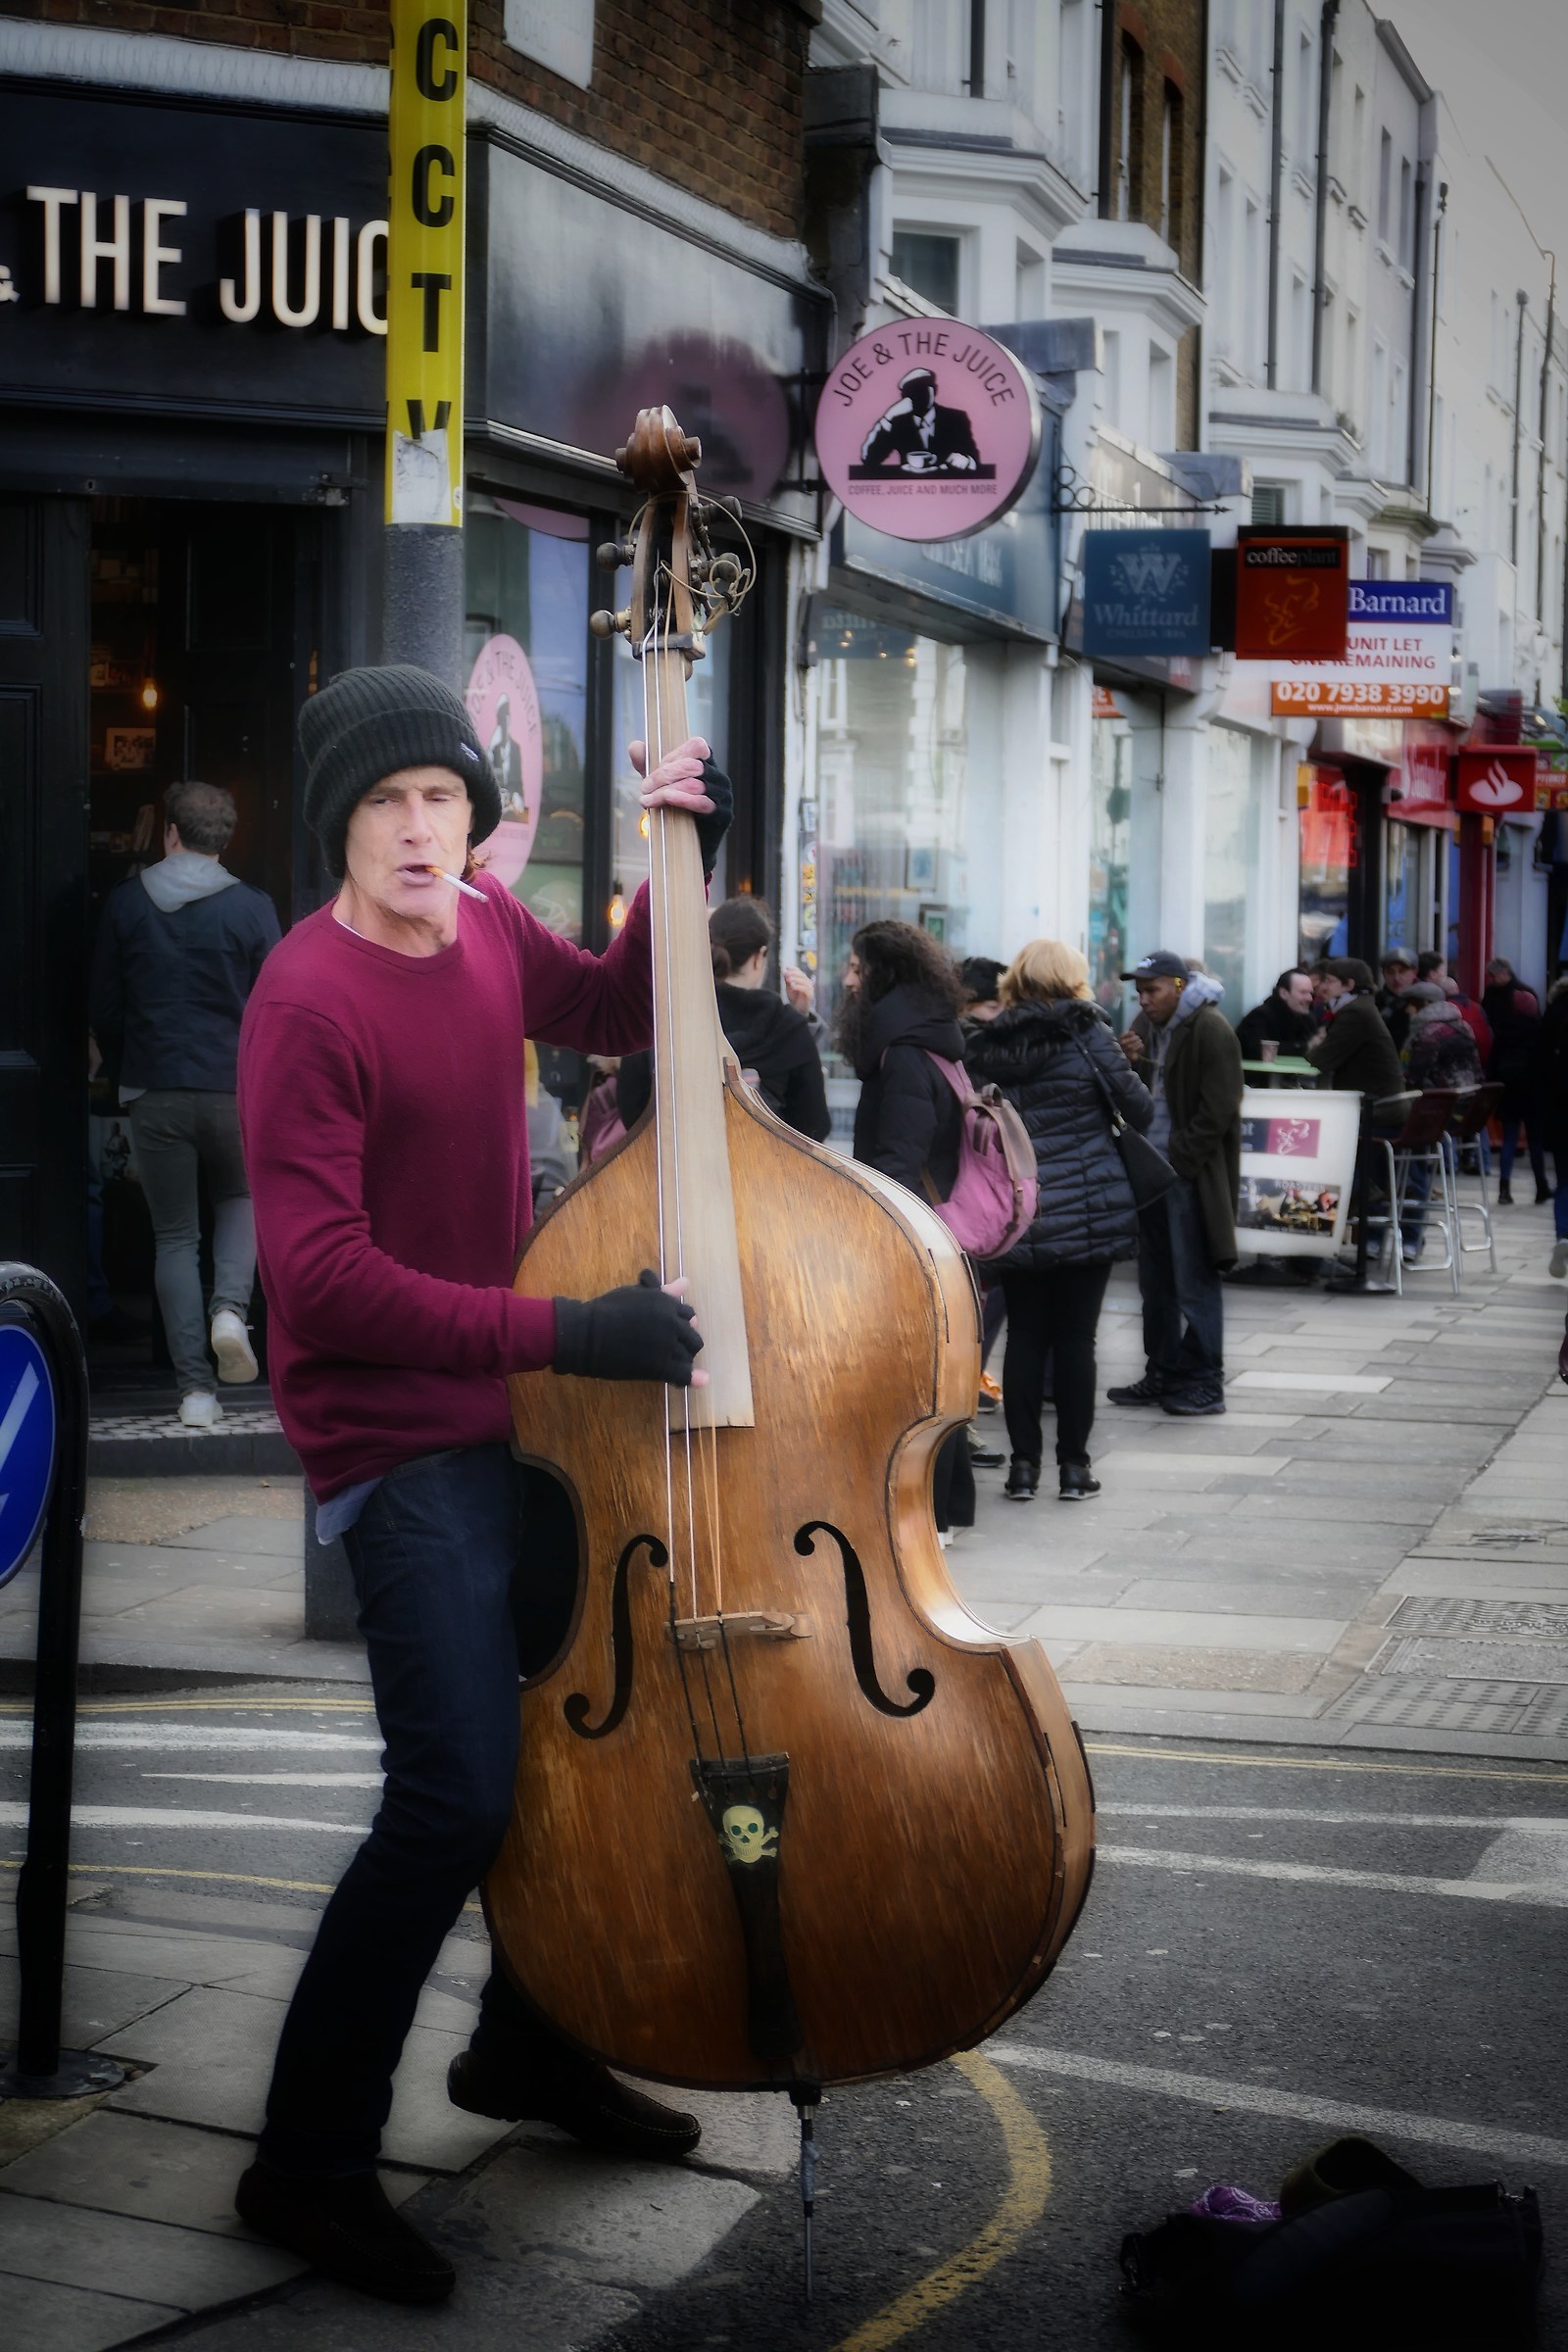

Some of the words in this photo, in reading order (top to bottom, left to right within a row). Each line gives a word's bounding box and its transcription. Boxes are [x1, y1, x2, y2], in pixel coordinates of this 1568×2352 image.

[26, 185, 187, 316] THE
[220, 208, 389, 335] JUIC
[833, 357, 873, 407] JOE
[872, 343, 895, 365] &
[898, 331, 950, 357] THE
[953, 344, 1015, 407] JUICE
[887, 484, 914, 495] JUICE
[917, 484, 938, 495] AND
[941, 484, 968, 495] MUCH
[970, 484, 998, 495] MORE
[1348, 587, 1446, 614] Barnard
[1093, 603, 1200, 627] Whittard
[1394, 638, 1424, 652] LET
[1276, 682, 1321, 702] 020
[1326, 683, 1383, 704] 7938
[1388, 684, 1445, 705] 3990
[1307, 703, 1413, 714] www.jmwbarnard.com
